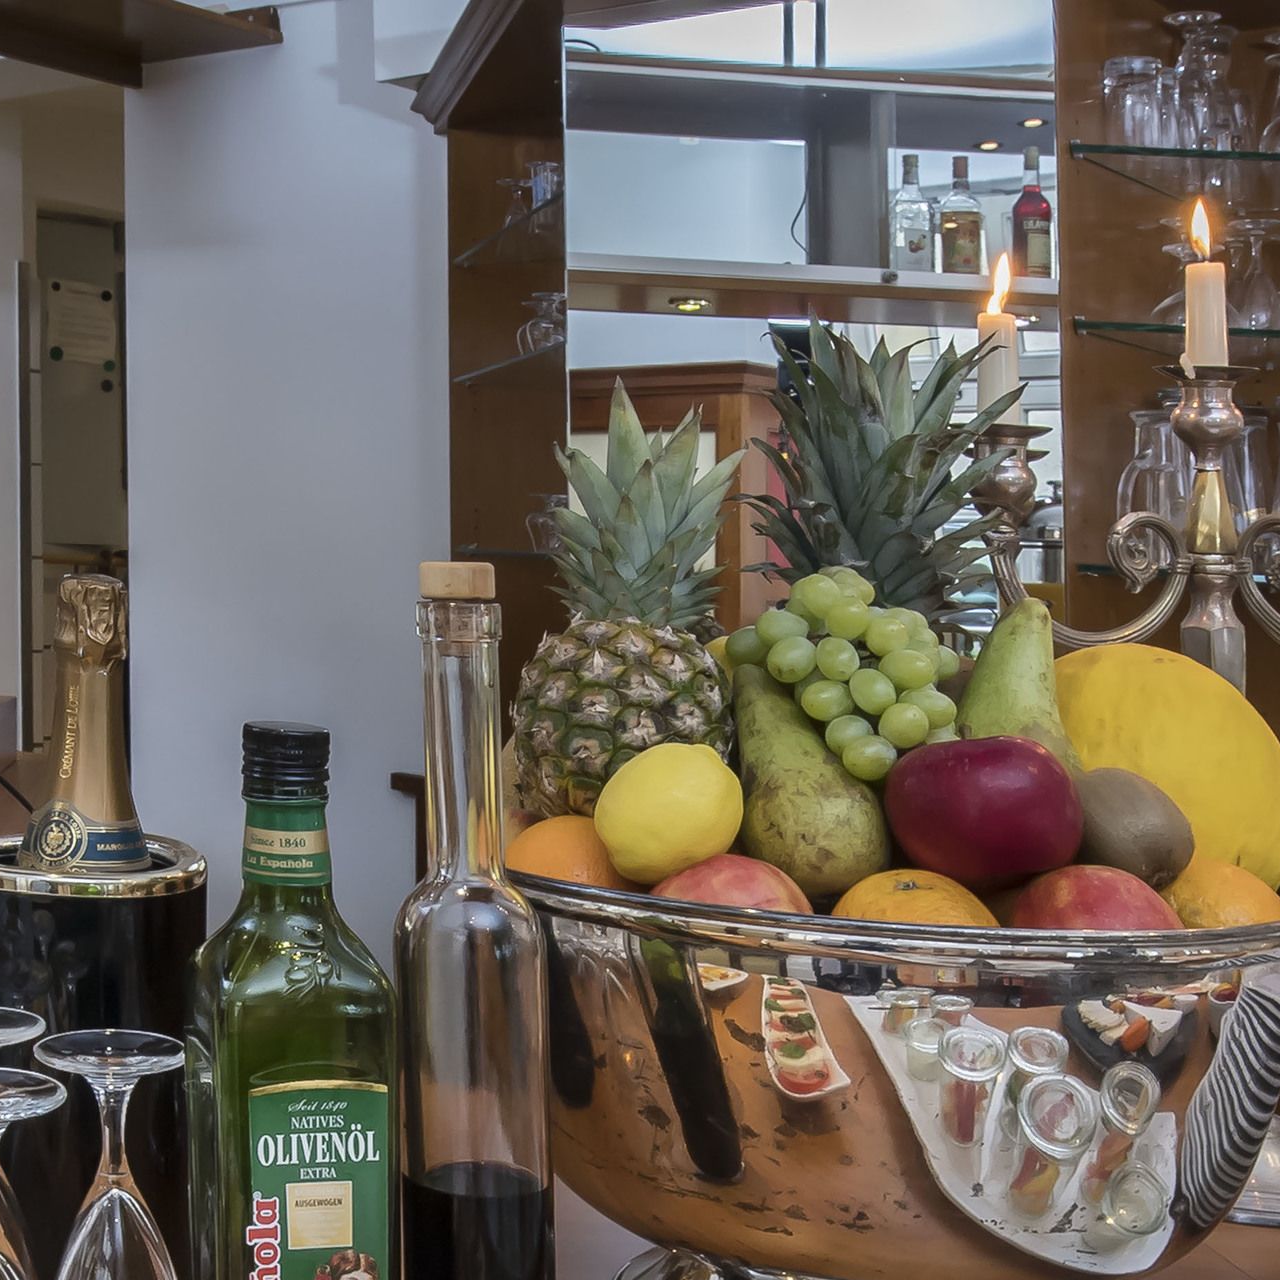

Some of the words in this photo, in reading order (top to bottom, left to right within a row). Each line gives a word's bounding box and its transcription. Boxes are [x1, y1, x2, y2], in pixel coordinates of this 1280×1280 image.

[279, 837, 306, 848] 1840
[291, 1114, 345, 1130] NATIVES
[257, 1123, 381, 1167] OLIVENÖL
[300, 1167, 337, 1180] EXTRA
[294, 1198, 344, 1208] AUSGEWOGEN
